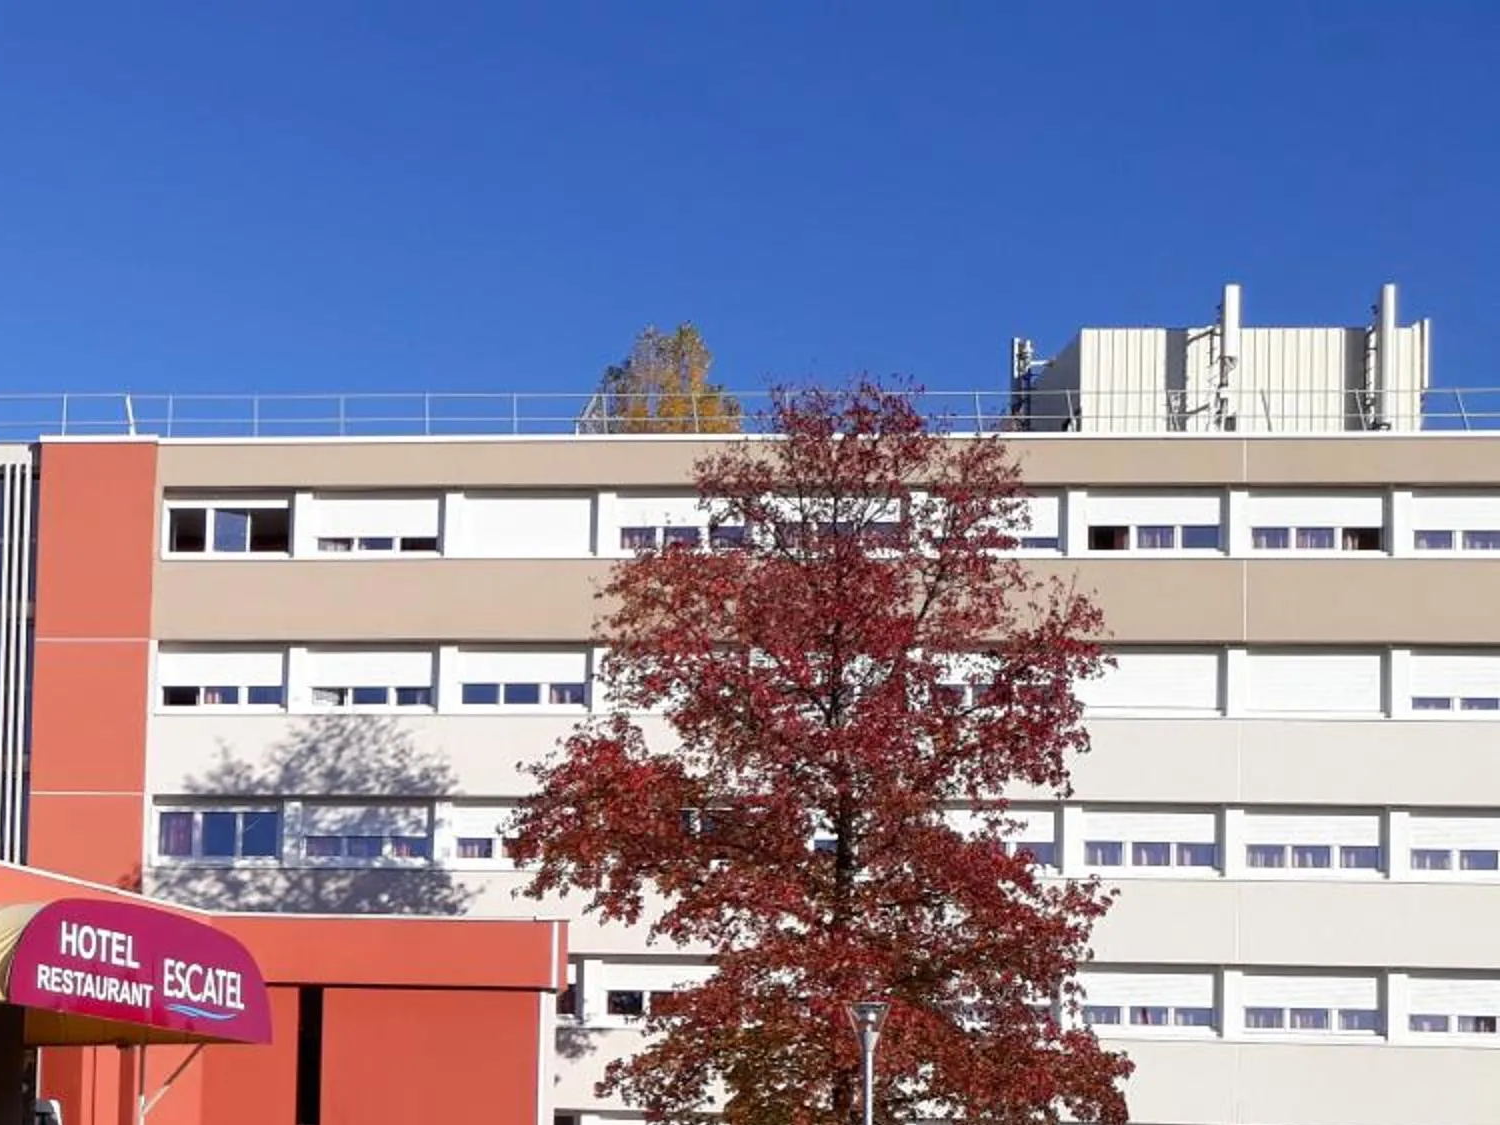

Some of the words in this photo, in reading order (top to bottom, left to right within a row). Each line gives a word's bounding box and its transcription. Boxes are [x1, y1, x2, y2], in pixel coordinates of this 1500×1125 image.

[60, 920, 140, 969] HOTEL
[37, 963, 154, 1009] RESTAURANT
[163, 957, 245, 1010] ESCATEL
